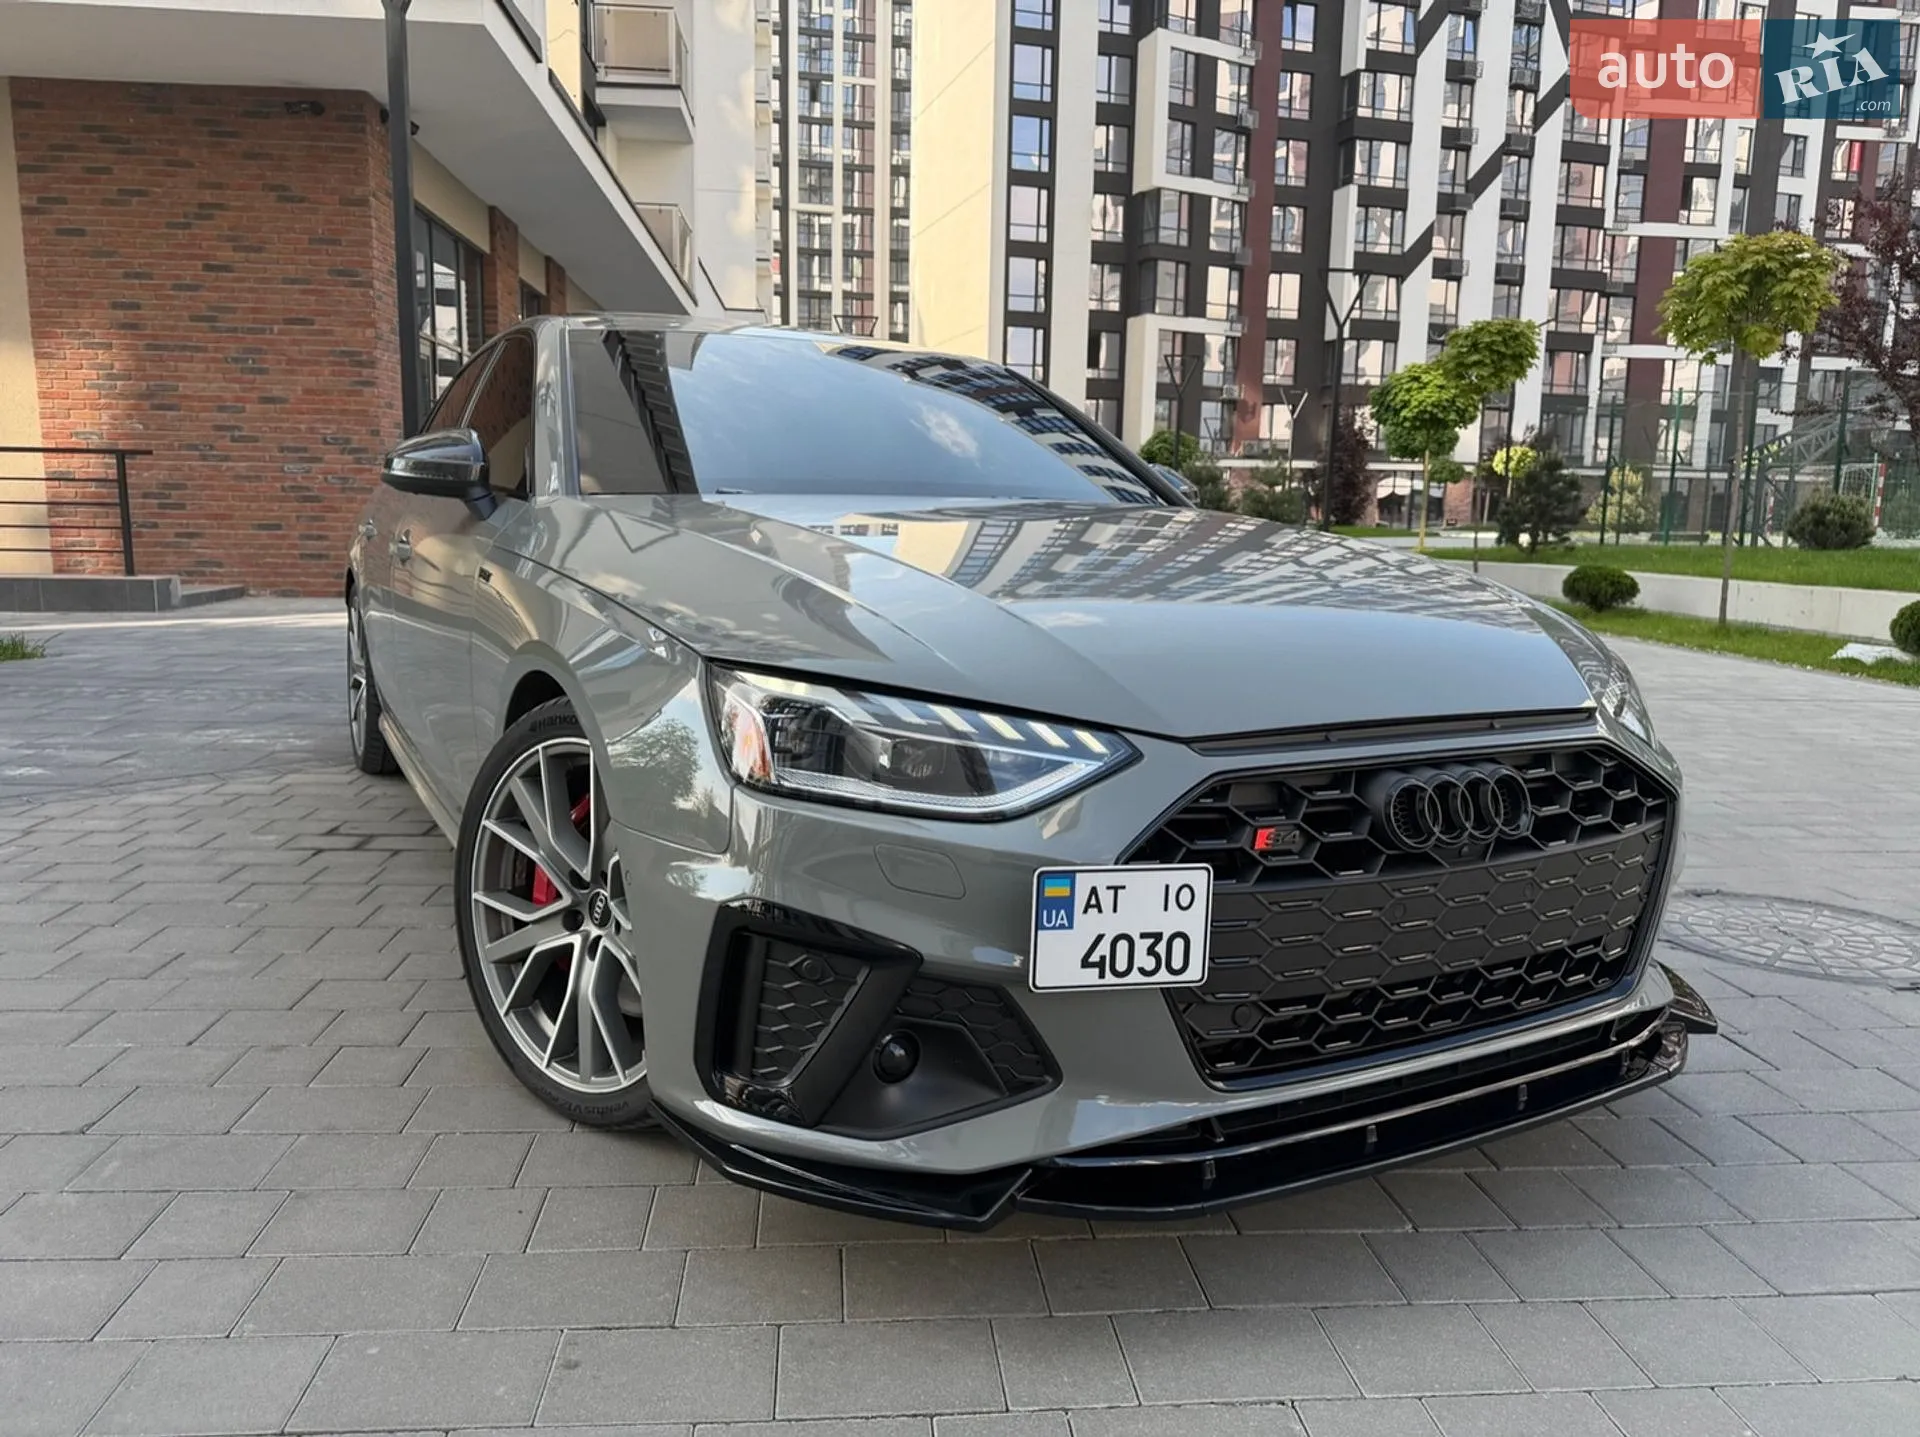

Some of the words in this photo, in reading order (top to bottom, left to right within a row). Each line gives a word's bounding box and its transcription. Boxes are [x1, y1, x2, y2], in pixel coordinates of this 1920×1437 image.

[1082, 885, 1126, 914] AT
[1163, 883, 1196, 912] IO
[1043, 909, 1069, 928] UA
[1080, 931, 1191, 979] 4030
